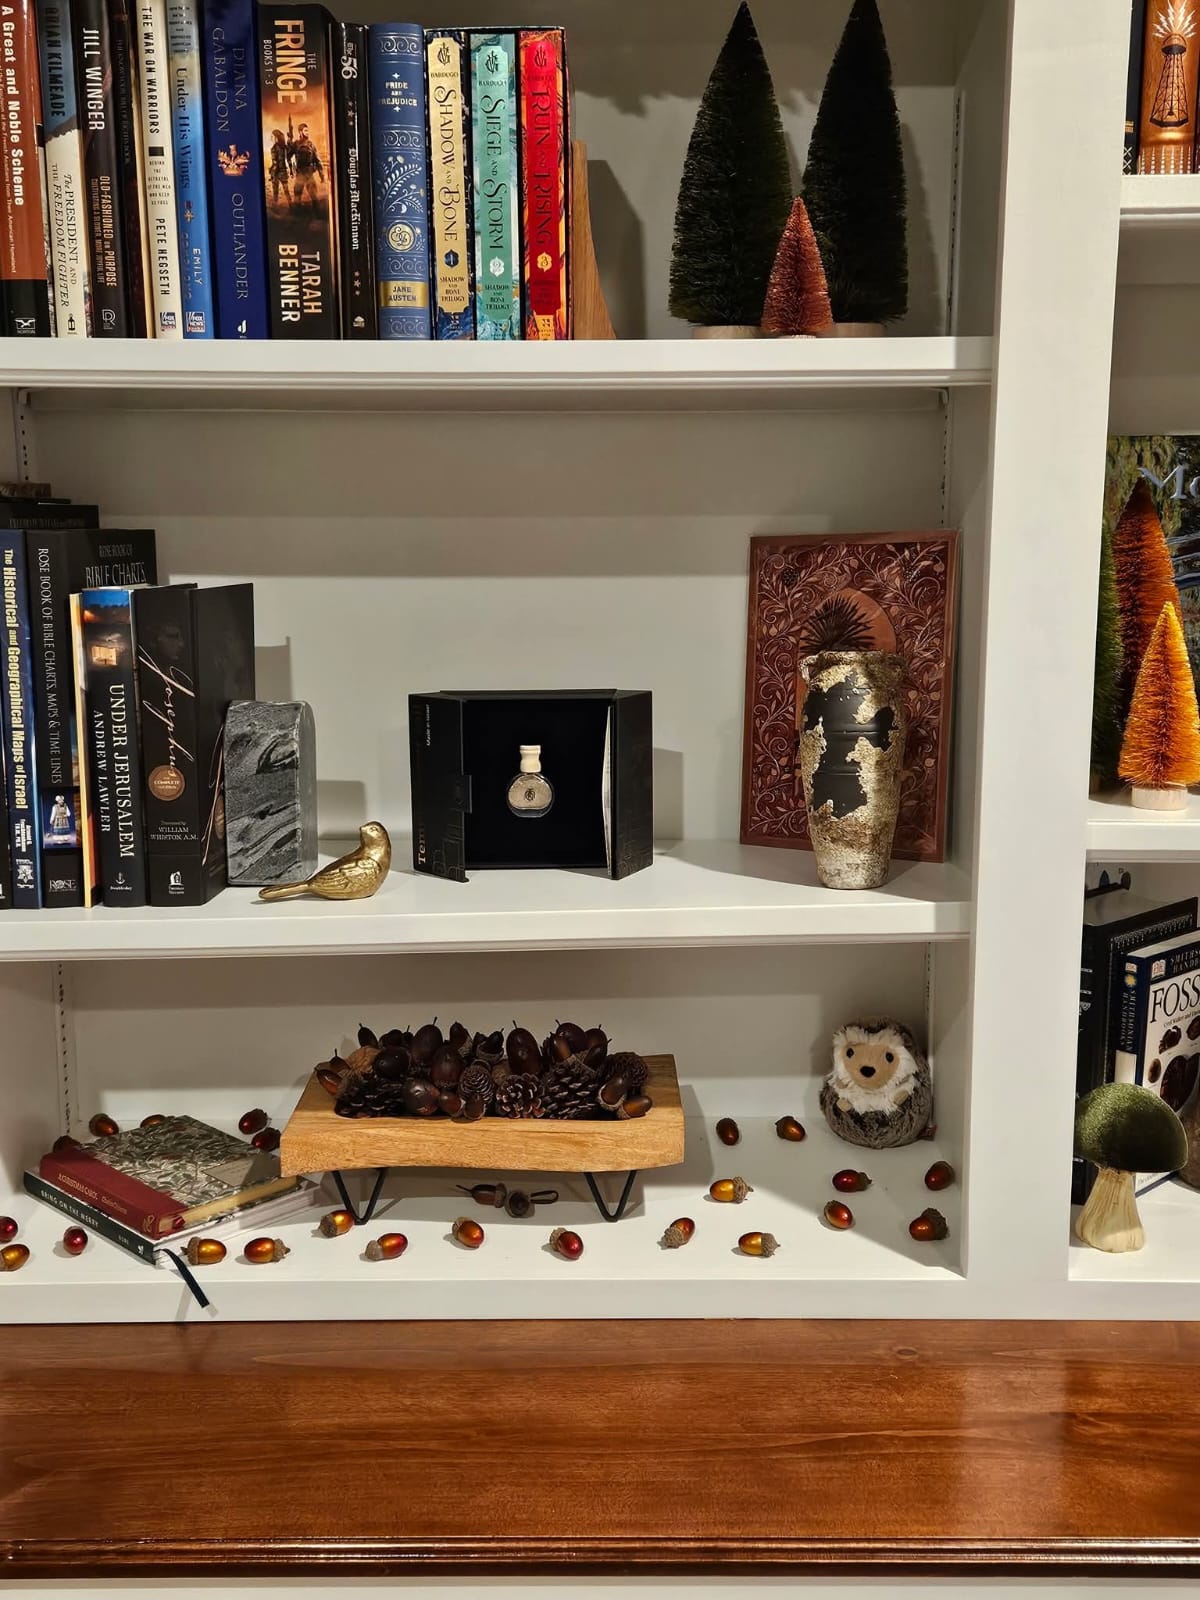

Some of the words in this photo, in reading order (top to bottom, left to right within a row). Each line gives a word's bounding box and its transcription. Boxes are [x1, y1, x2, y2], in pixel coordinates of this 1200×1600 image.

[1, 5, 14, 16] A
[142, 6, 153, 27] THE
[3, 22, 16, 62] Great
[82, 27, 100, 58] JILL
[143, 32, 155, 54] WAR
[263, 39, 273, 65] BOOKS
[306, 52, 317, 70] THE
[145, 59, 156, 73] ON
[212, 27, 229, 132] GABALDON
[231, 48, 248, 110] DIANA
[274, 20, 307, 104] FRINGE
[341, 56, 359, 80] 56
[5, 68, 19, 95] and
[47, 52, 66, 117] KILMEADE
[85, 66, 105, 130] WINGER
[176, 68, 190, 111] Under
[385, 81, 408, 89] PRIDE
[7, 101, 22, 143] Noble
[146, 78, 160, 134] WARRIORS
[480, 94, 507, 156] SIEGE
[531, 87, 551, 145] RUIN
[178, 116, 191, 140] His
[434, 86, 457, 169] SHADOW
[11, 149, 25, 205] Scheme
[51, 163, 59, 182] THE
[63, 173, 73, 189] The
[179, 144, 193, 189] Wings
[347, 148, 360, 189] Douglas
[490, 159, 498, 176] AND
[53, 184, 66, 248] FREEDOM
[99, 176, 114, 239] OLD-FASHIONED
[350, 190, 361, 250] MacKinnon
[438, 184, 461, 242] BONE
[482, 178, 508, 249] STORM
[533, 168, 554, 245] RISING
[65, 191, 79, 265] PRESIDENT
[155, 218, 167, 244] PETE
[231, 193, 249, 300] OUTLANDER
[57, 250, 70, 307] FIGHTER
[69, 268, 77, 285] AND
[104, 250, 117, 287] PURPOSE
[158, 249, 171, 295] HEGSETH
[192, 248, 203, 286] EMILY
[278, 244, 301, 322] BENNER
[301, 251, 323, 313] TARAH
[388, 294, 416, 302] AUSTEN
[4, 549, 14, 565] The
[38, 548, 50, 573] ROSE
[85, 565, 111, 588] BIBLE
[112, 562, 147, 586] CHARTS
[3, 567, 20, 628] Historical
[39, 576, 52, 605] BOOK
[41, 607, 53, 621] OF
[8, 629, 18, 646] and
[42, 623, 55, 648] BIBLE
[7, 647, 24, 728] Geographical
[47, 693, 59, 718] MAPS
[48, 720, 61, 728] &
[109, 683, 128, 747] UNDER
[138, 645, 196, 777] Josephus
[12, 730, 25, 762] Maps
[49, 730, 61, 754] TIME
[93, 710, 108, 771] ANDREW
[16, 765, 25, 774] of
[50, 757, 62, 784] LINES
[14, 775, 28, 809] Israel
[97, 776, 111, 832] LAWLER
[113, 752, 135, 858] JERUSALEM
[49, 879, 77, 889] ROSE
[41, 1190, 58, 1204] BRING
[59, 1200, 68, 1210] ON
[69, 1206, 79, 1217] THE
[80, 1212, 99, 1227] MERRY
